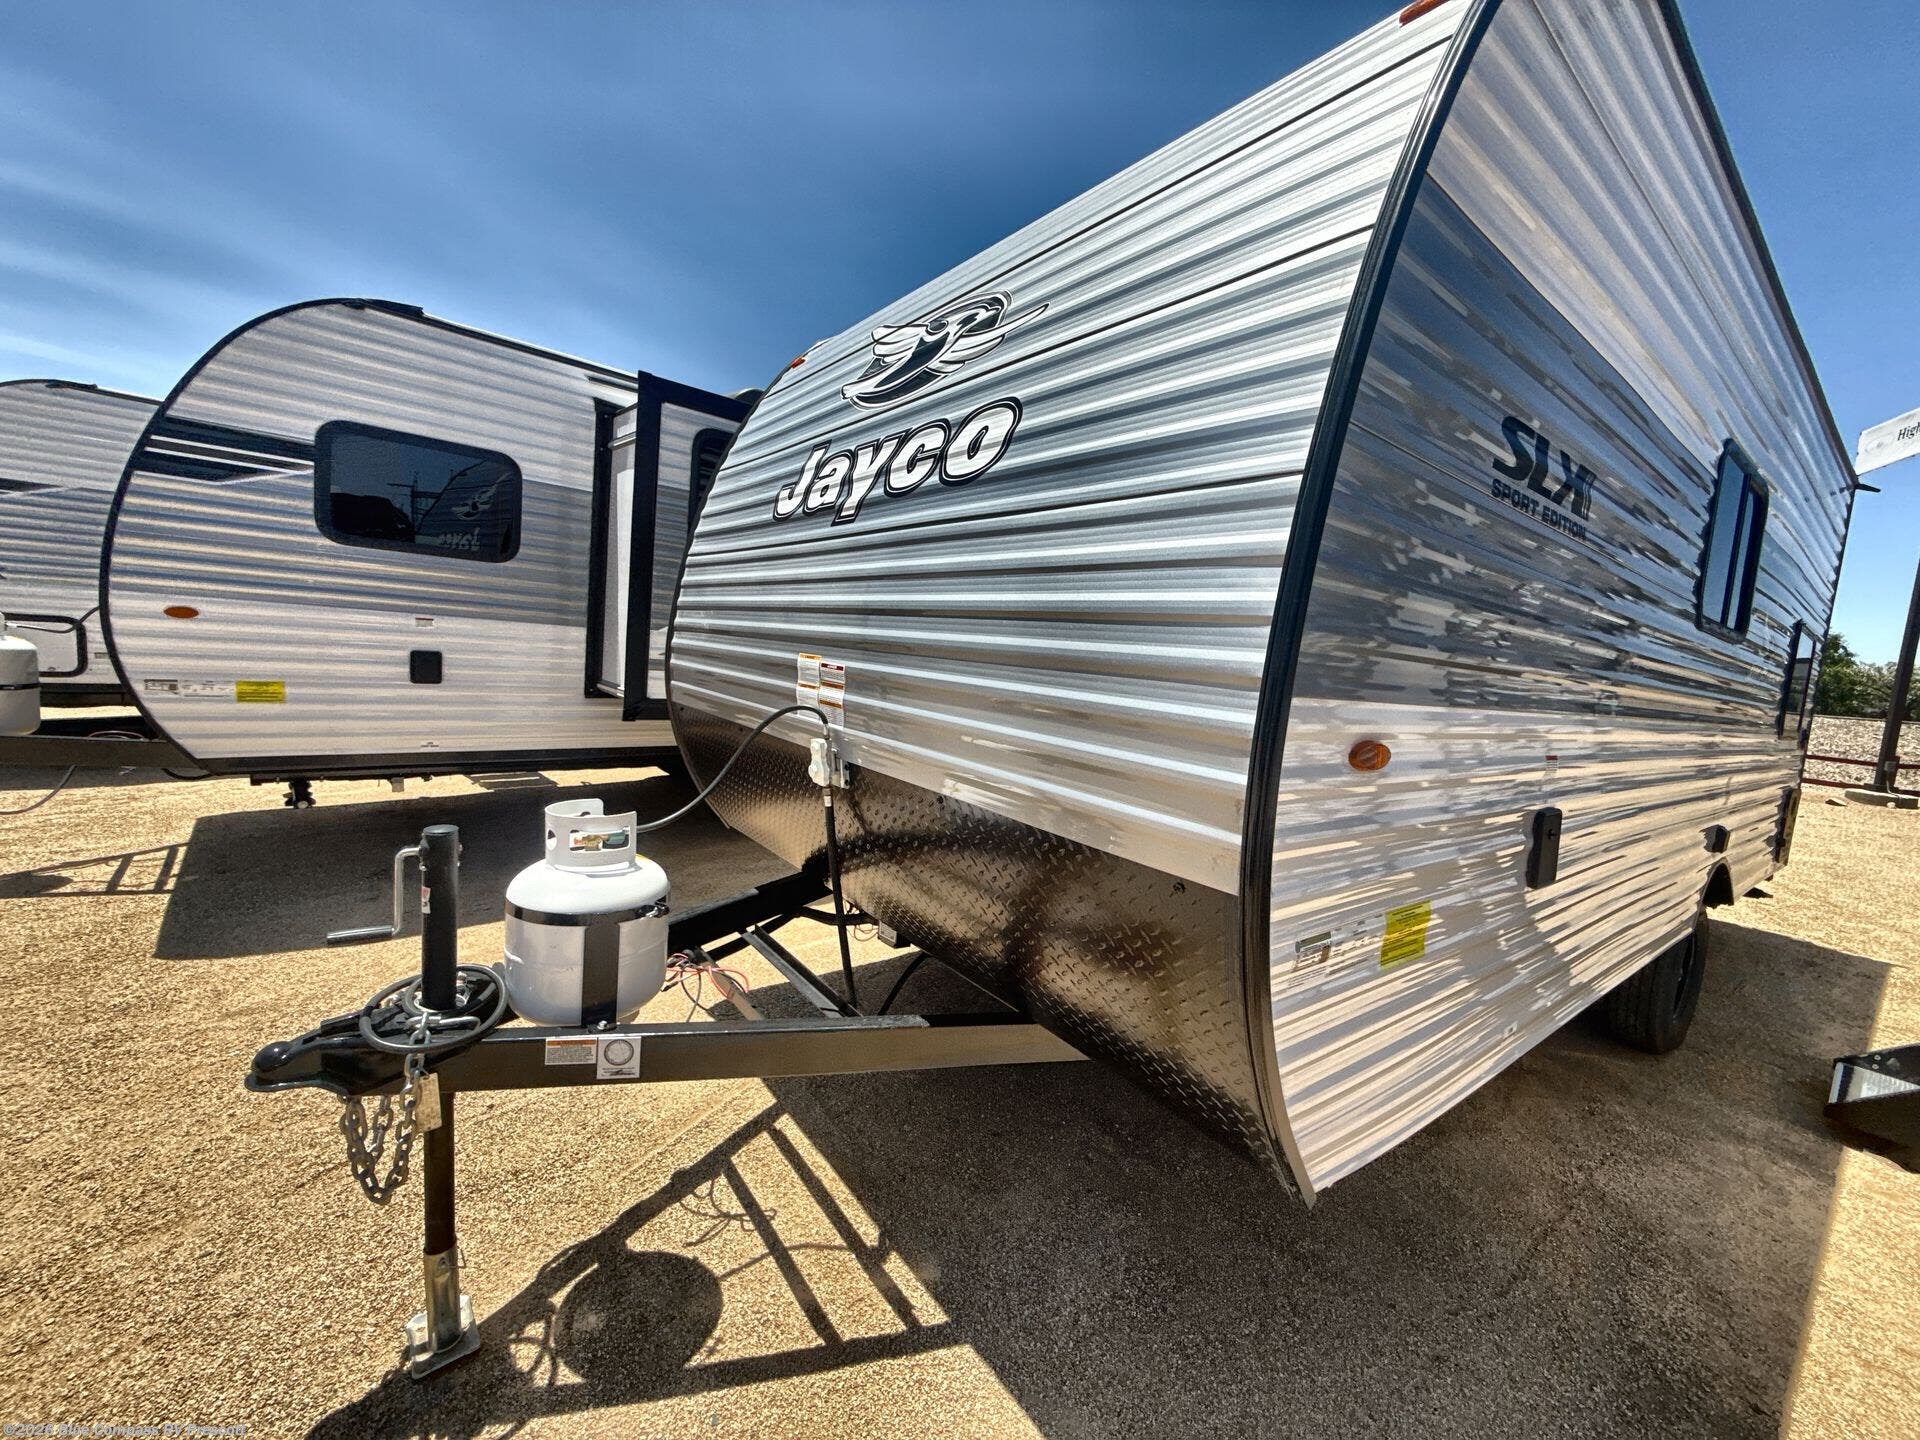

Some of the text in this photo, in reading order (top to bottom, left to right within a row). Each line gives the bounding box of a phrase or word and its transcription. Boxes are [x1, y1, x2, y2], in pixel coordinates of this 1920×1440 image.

[773, 397, 1023, 526] Jayco
[1491, 478, 1586, 541] SPORT EDITION
[1492, 416, 1597, 521] SLX
